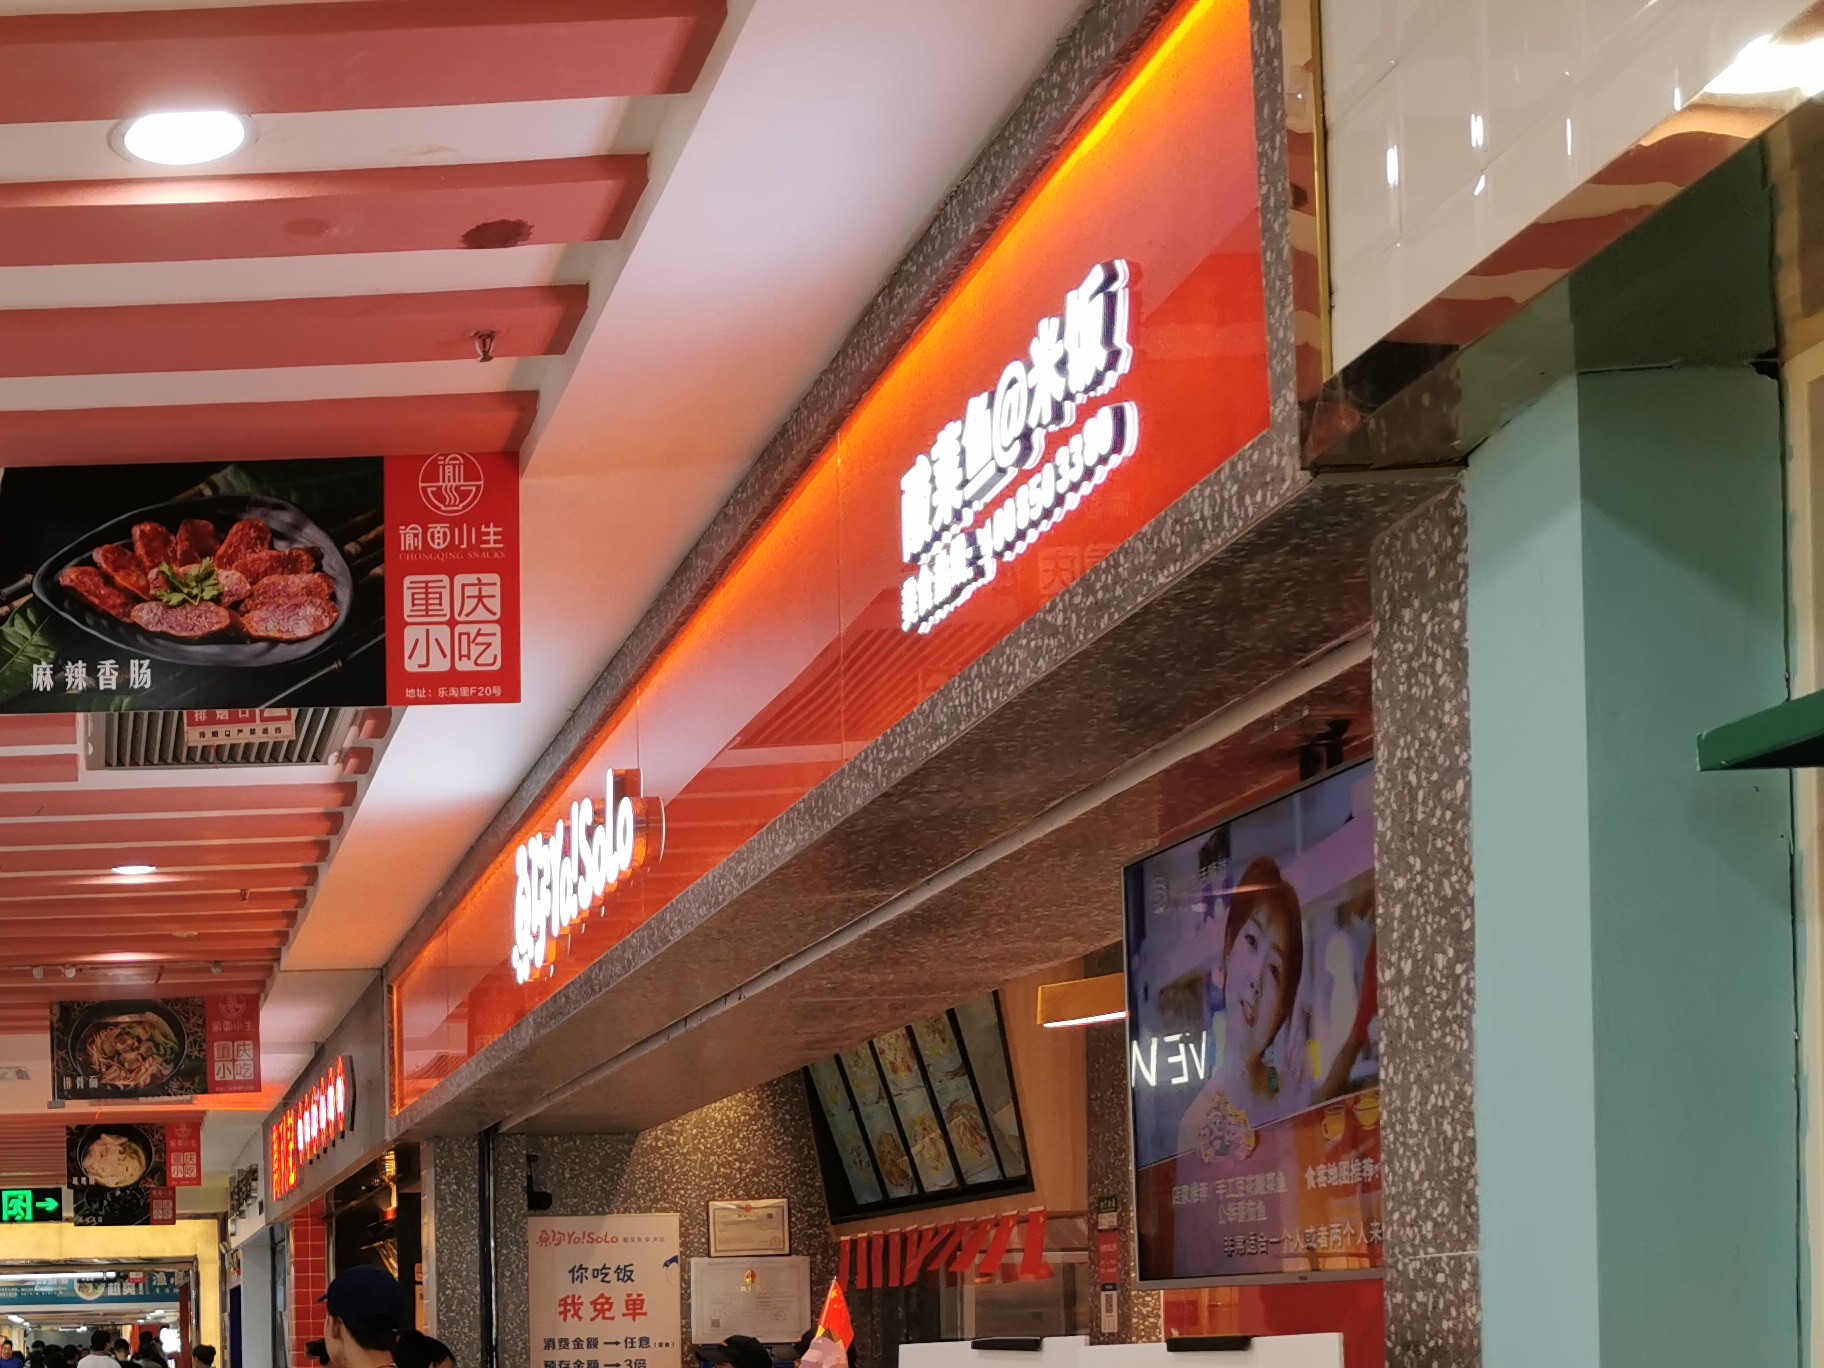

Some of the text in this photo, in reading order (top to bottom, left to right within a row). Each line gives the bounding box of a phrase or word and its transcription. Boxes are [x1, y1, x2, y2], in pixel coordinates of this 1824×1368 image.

[399, 551, 506, 562] CHONGQING SNACKS
[406, 577, 498, 619] 重庆
[407, 627, 498, 669] 小吃
[31, 658, 153, 692] 麻辣香肠
[568, 1263, 636, 1284] 你吃饭
[558, 1292, 648, 1322] 我免单
[543, 1337, 599, 1350] 消费金额
[624, 1336, 651, 1349] 任意
